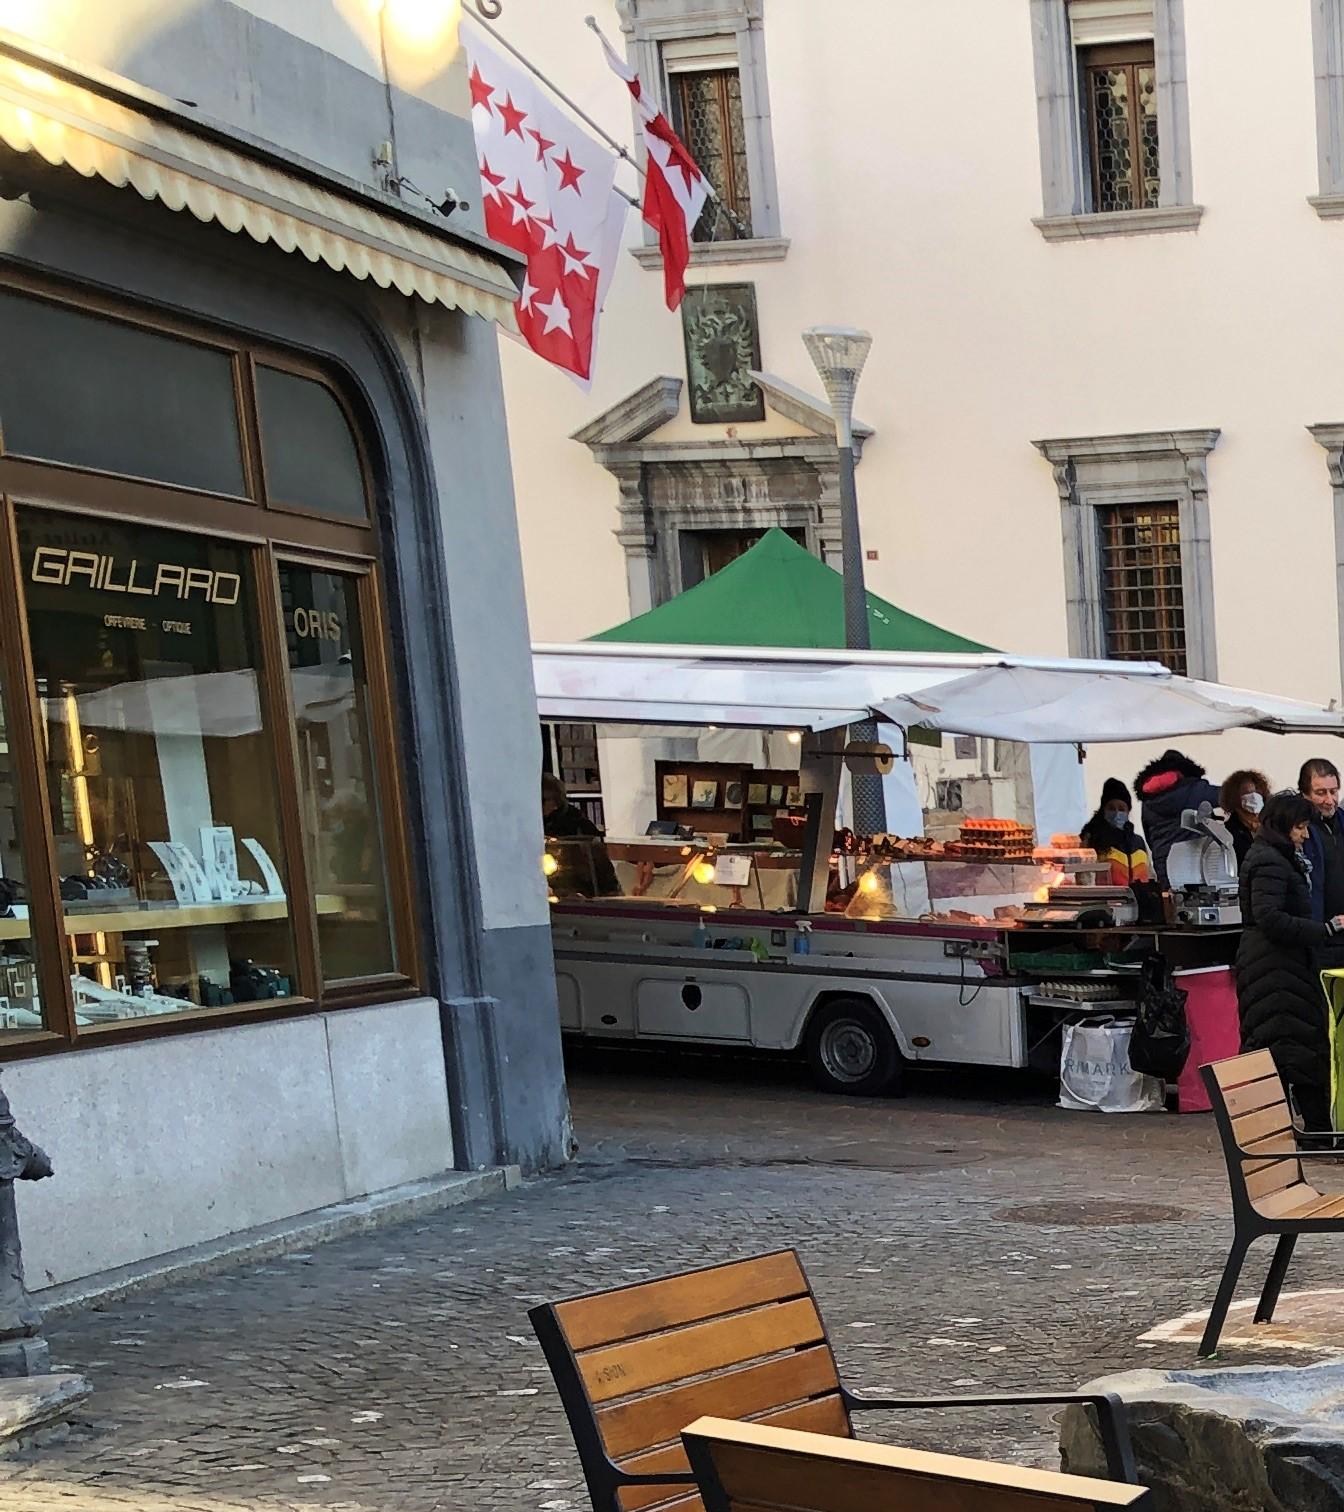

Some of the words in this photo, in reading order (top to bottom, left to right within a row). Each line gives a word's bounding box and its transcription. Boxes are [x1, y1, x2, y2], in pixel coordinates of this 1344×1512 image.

[32, 546, 240, 605] GAILLARD
[294, 608, 341, 641] ORIS
[1064, 1058, 1130, 1077] RIMARK
